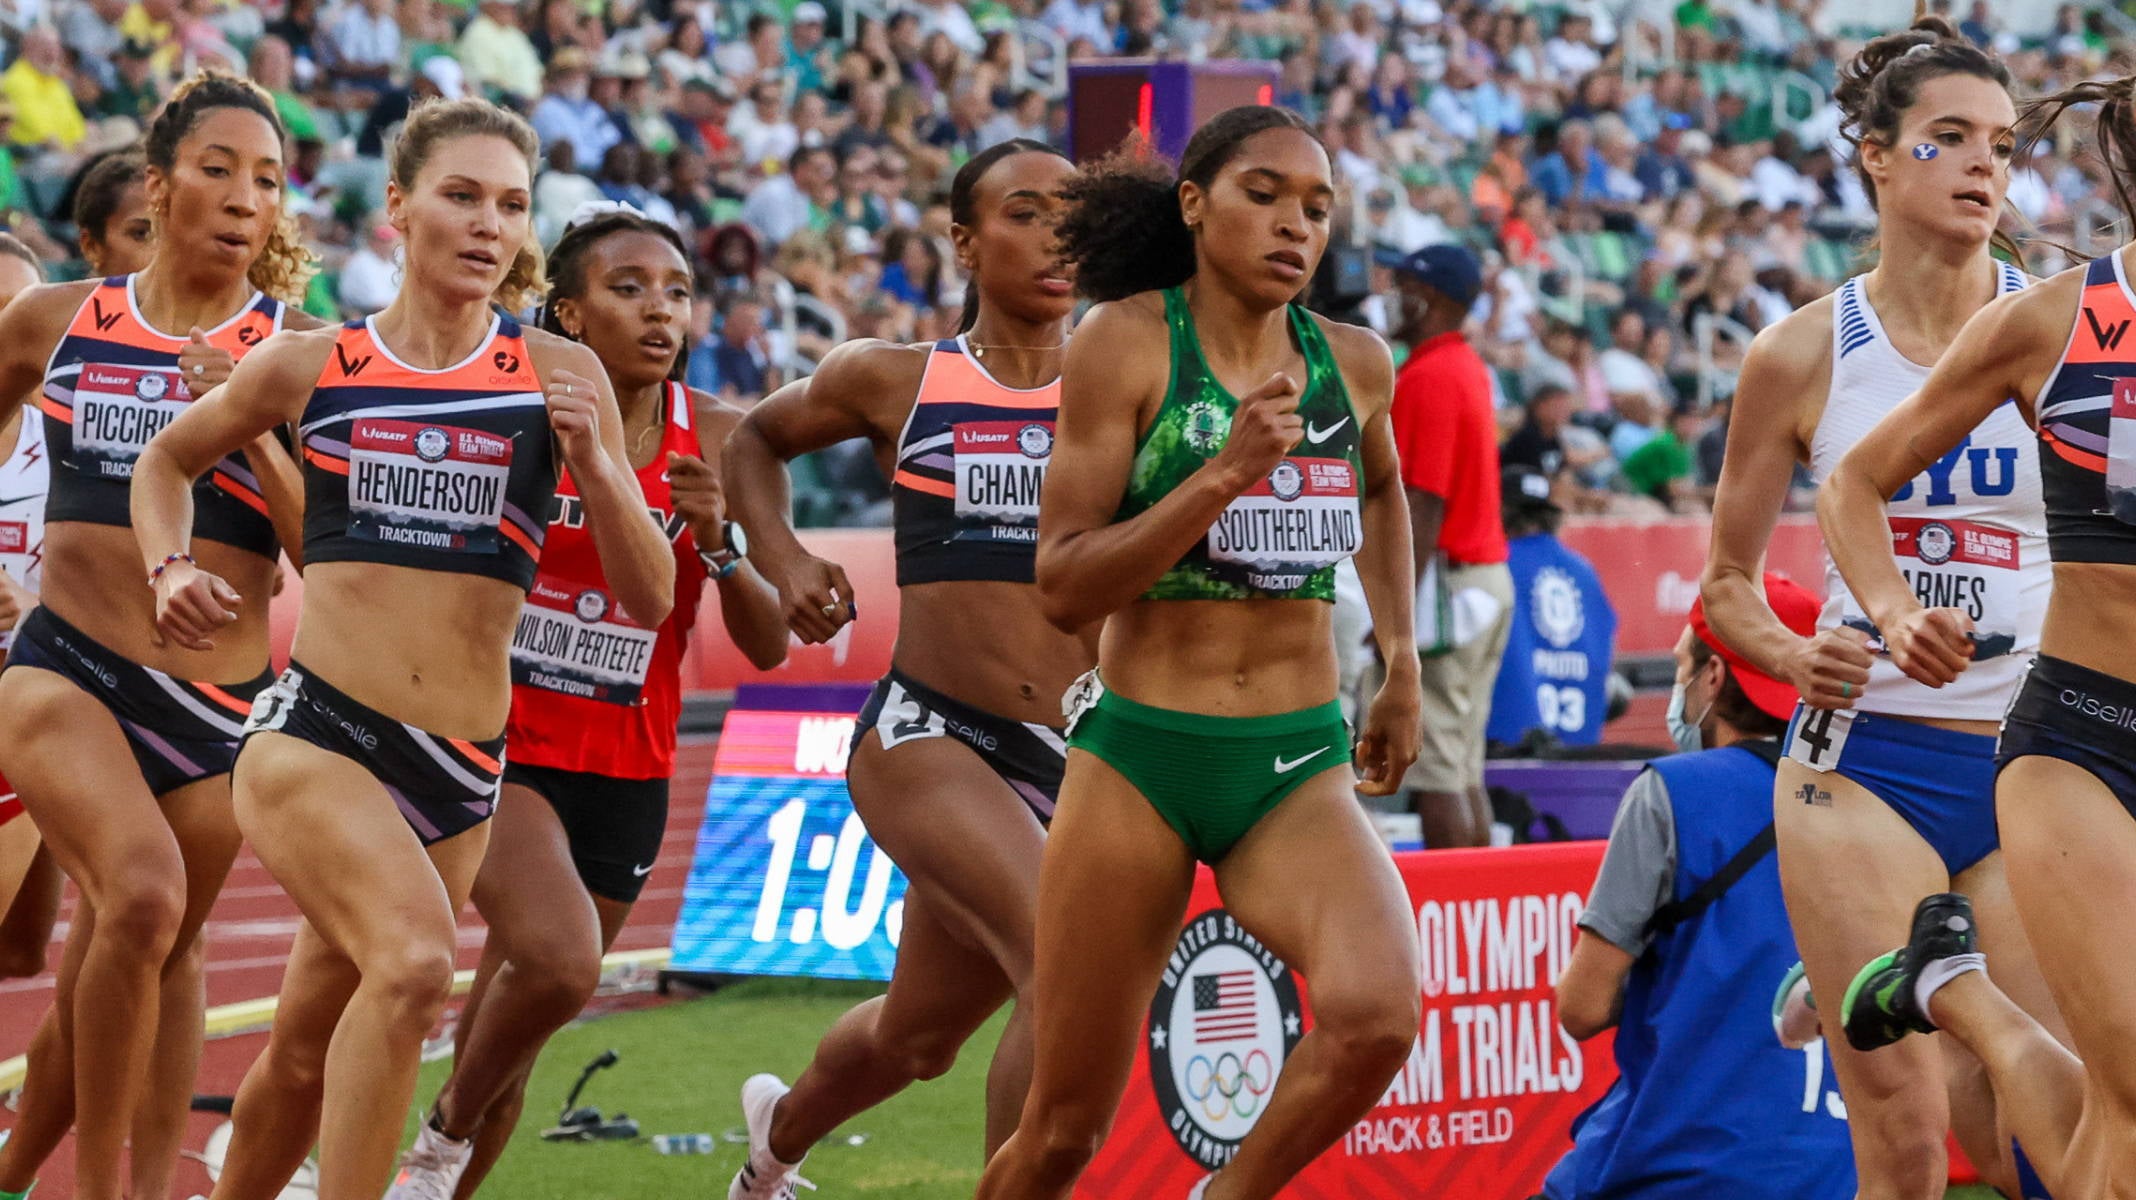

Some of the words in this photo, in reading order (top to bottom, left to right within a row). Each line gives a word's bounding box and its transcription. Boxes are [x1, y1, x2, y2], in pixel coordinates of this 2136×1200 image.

[83, 402, 174, 444] PICCIRI
[100, 460, 134, 477] TRACK
[356, 461, 499, 516] HENDERSON
[968, 464, 1048, 506] CHAM
[1889, 434, 2018, 506] YU
[991, 525, 1040, 540] TRACKT
[1217, 509, 1356, 552] SOUTHERLAND
[513, 612, 574, 660] WILSON
[572, 628, 648, 674] PERTEETE
[1799, 707, 1833, 764] 4
[1452, 1000, 1584, 1101] TRIALS
[1448, 1107, 1513, 1147] FIELD
